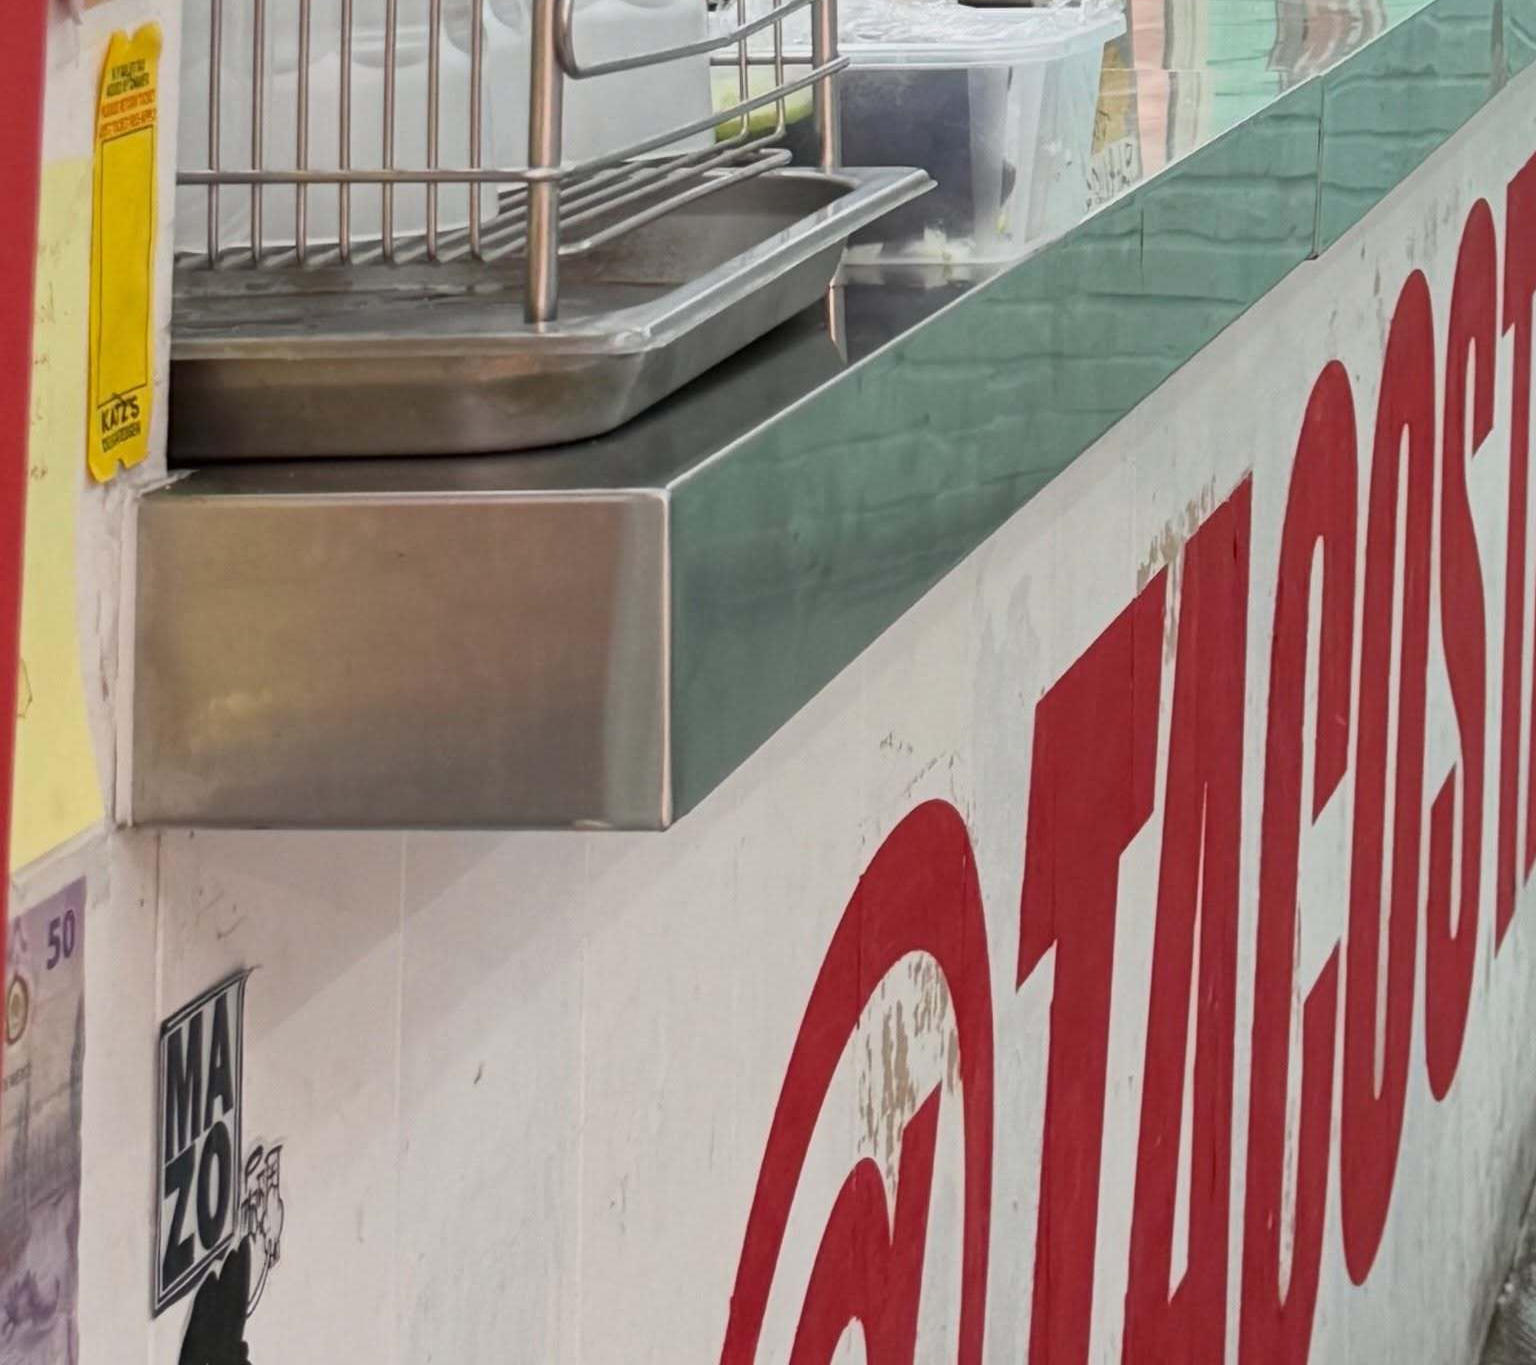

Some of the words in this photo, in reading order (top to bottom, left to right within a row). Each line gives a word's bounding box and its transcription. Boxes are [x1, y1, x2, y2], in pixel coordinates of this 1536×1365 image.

[47, 909, 75, 970] 50
[164, 990, 235, 1165] MA
[162, 1120, 232, 1291] ZO
